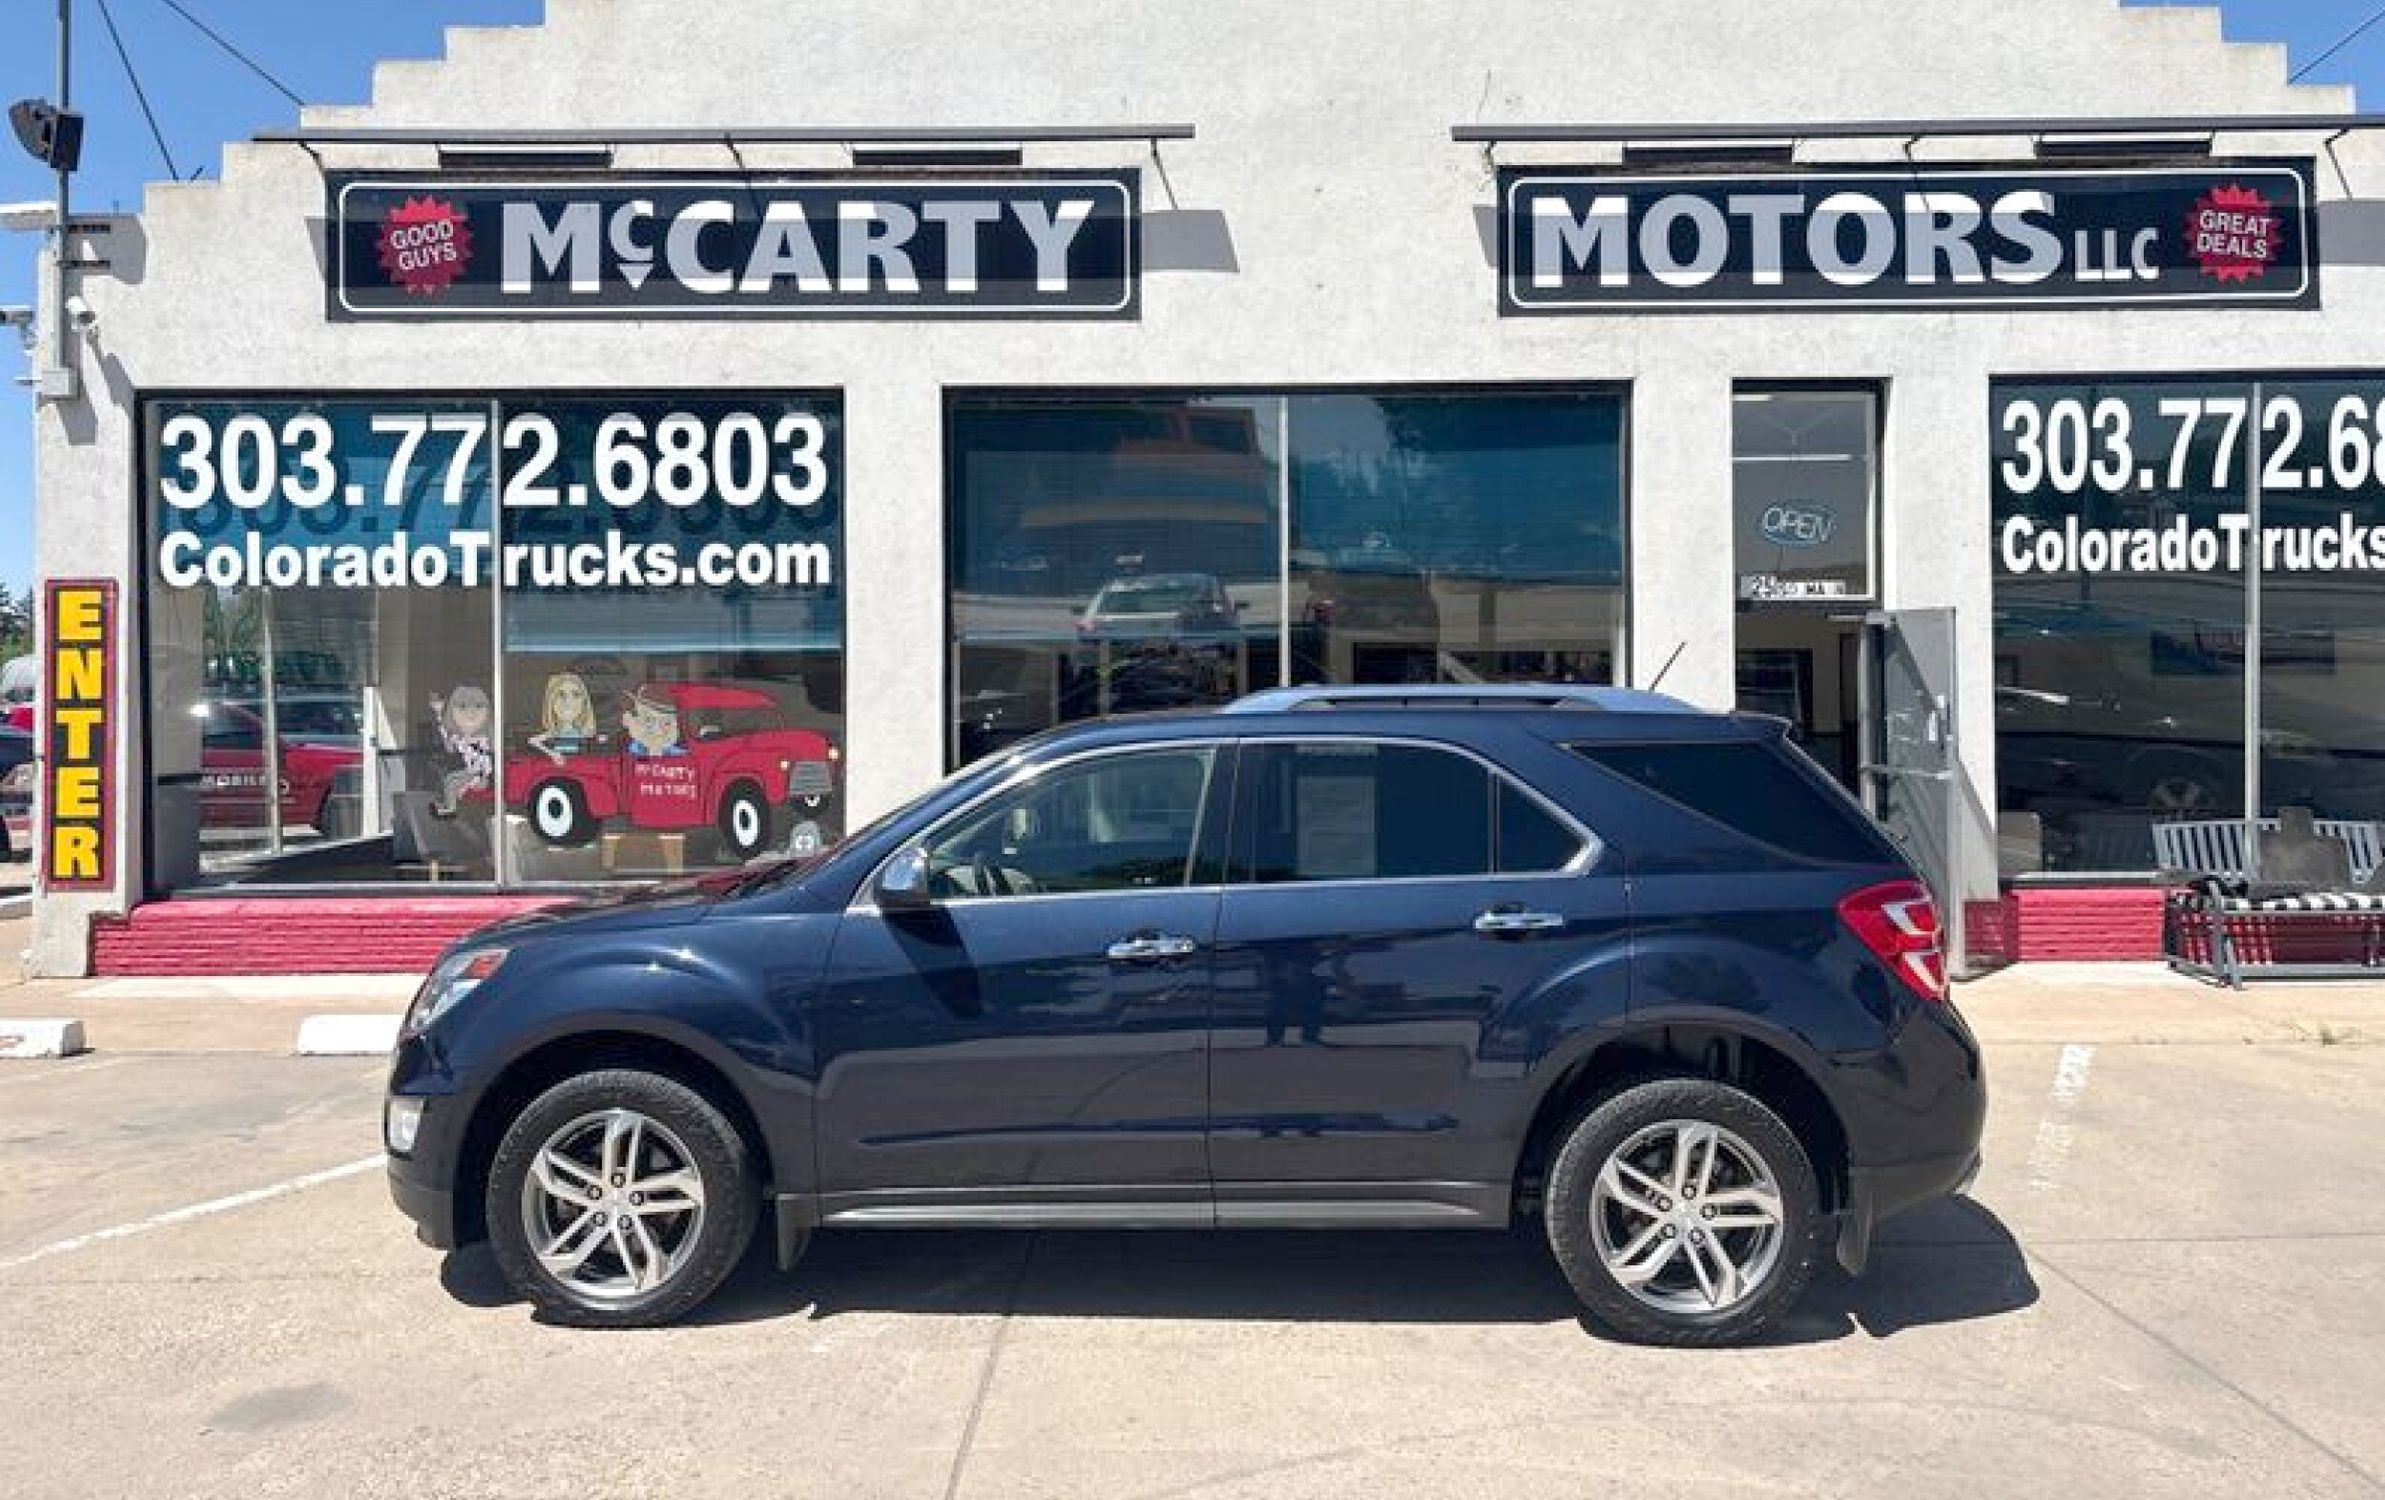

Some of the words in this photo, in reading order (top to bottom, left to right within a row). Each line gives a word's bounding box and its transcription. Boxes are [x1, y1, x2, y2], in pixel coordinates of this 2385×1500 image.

[390, 220, 454, 250] GOOD
[1532, 189, 2064, 287] MOTORS
[2074, 227, 2160, 280] LLC
[2199, 209, 2272, 238] GREAT
[398, 241, 457, 271] GUYS
[2196, 232, 2268, 259] DEALS
[160, 413, 829, 510] 303.772.6803
[160, 531, 831, 588] ColoradoTrucks.com
[52, 590, 103, 879] ENTER
